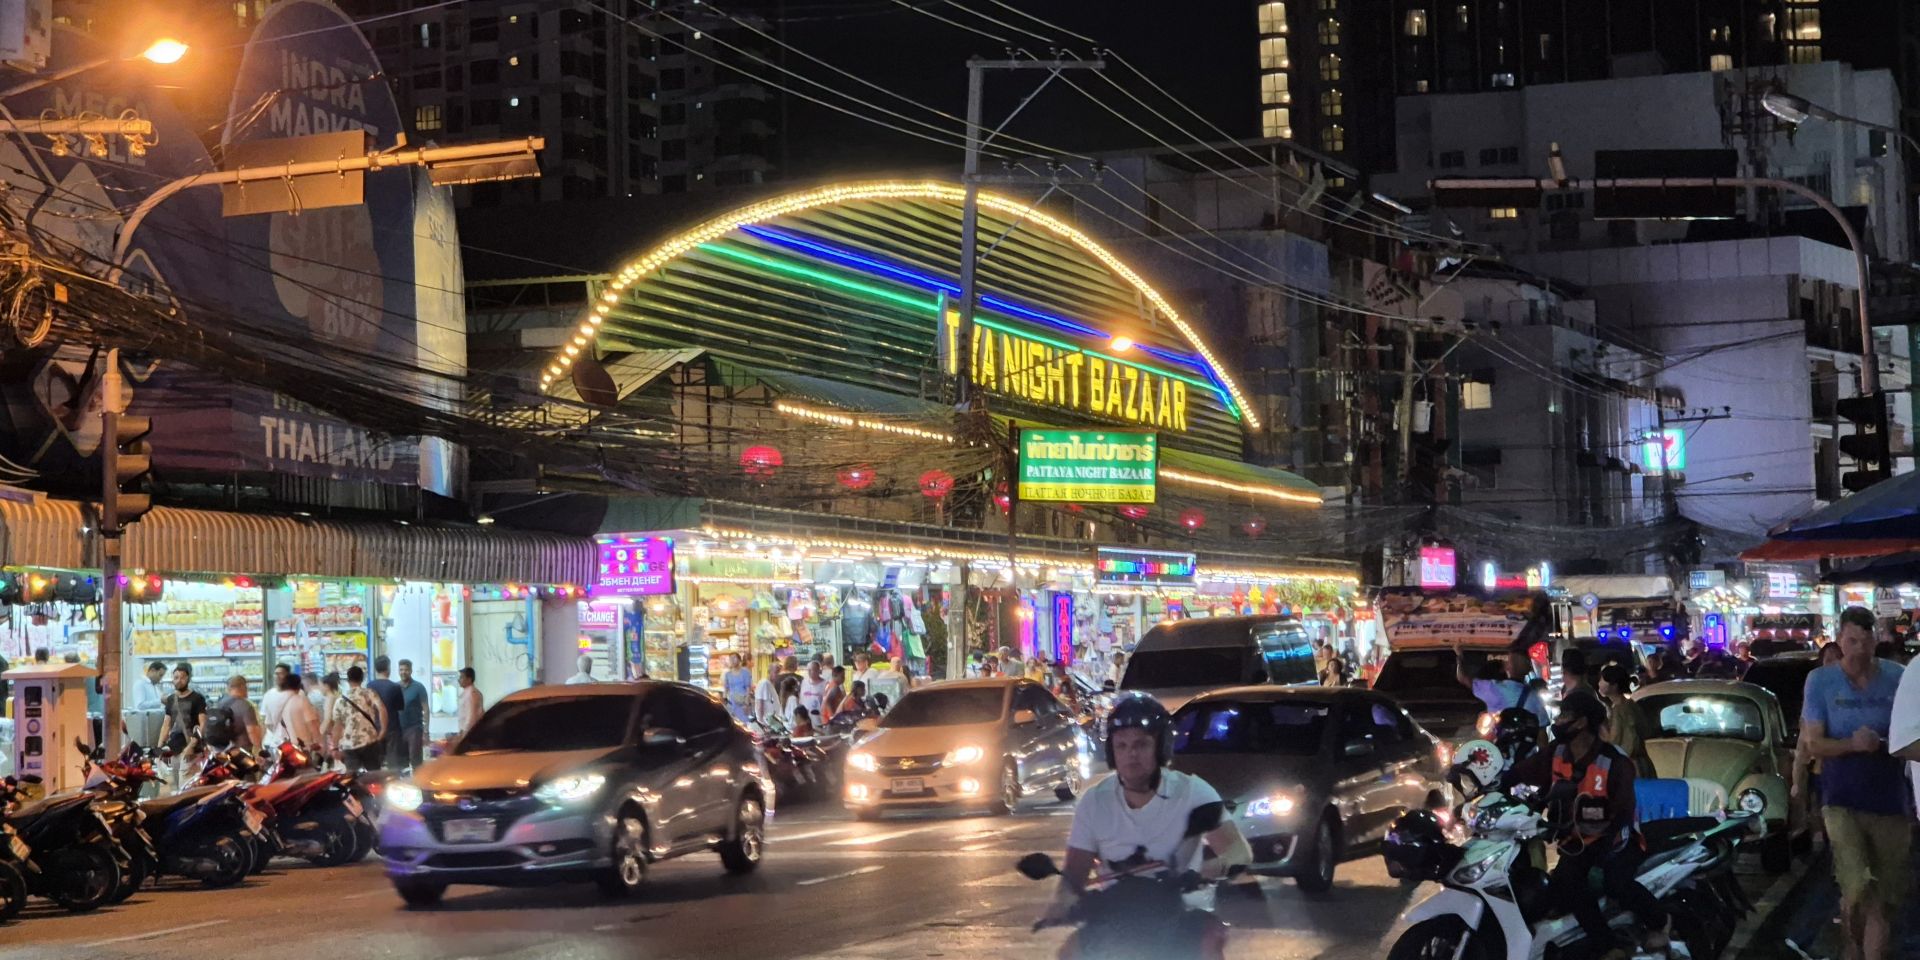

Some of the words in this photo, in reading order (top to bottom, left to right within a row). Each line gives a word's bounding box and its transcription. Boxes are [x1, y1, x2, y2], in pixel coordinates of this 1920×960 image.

[281, 48, 367, 117] INDRA
[270, 97, 379, 138] MAR
[1003, 332, 1083, 408] NIGHT
[1091, 357, 1187, 432] BAZAAR
[260, 415, 395, 470] THAILAND
[1026, 465, 1074, 478] PATTAYA
[1075, 466, 1107, 479] NIGHT
[1109, 466, 1152, 480] BAZAAR
[1117, 488, 1152, 501] БАЗАР
[631, 575, 662, 586] ДЕНЕГ
[1755, 615, 1811, 626] JALWA
[1594, 774, 1603, 791] 2
